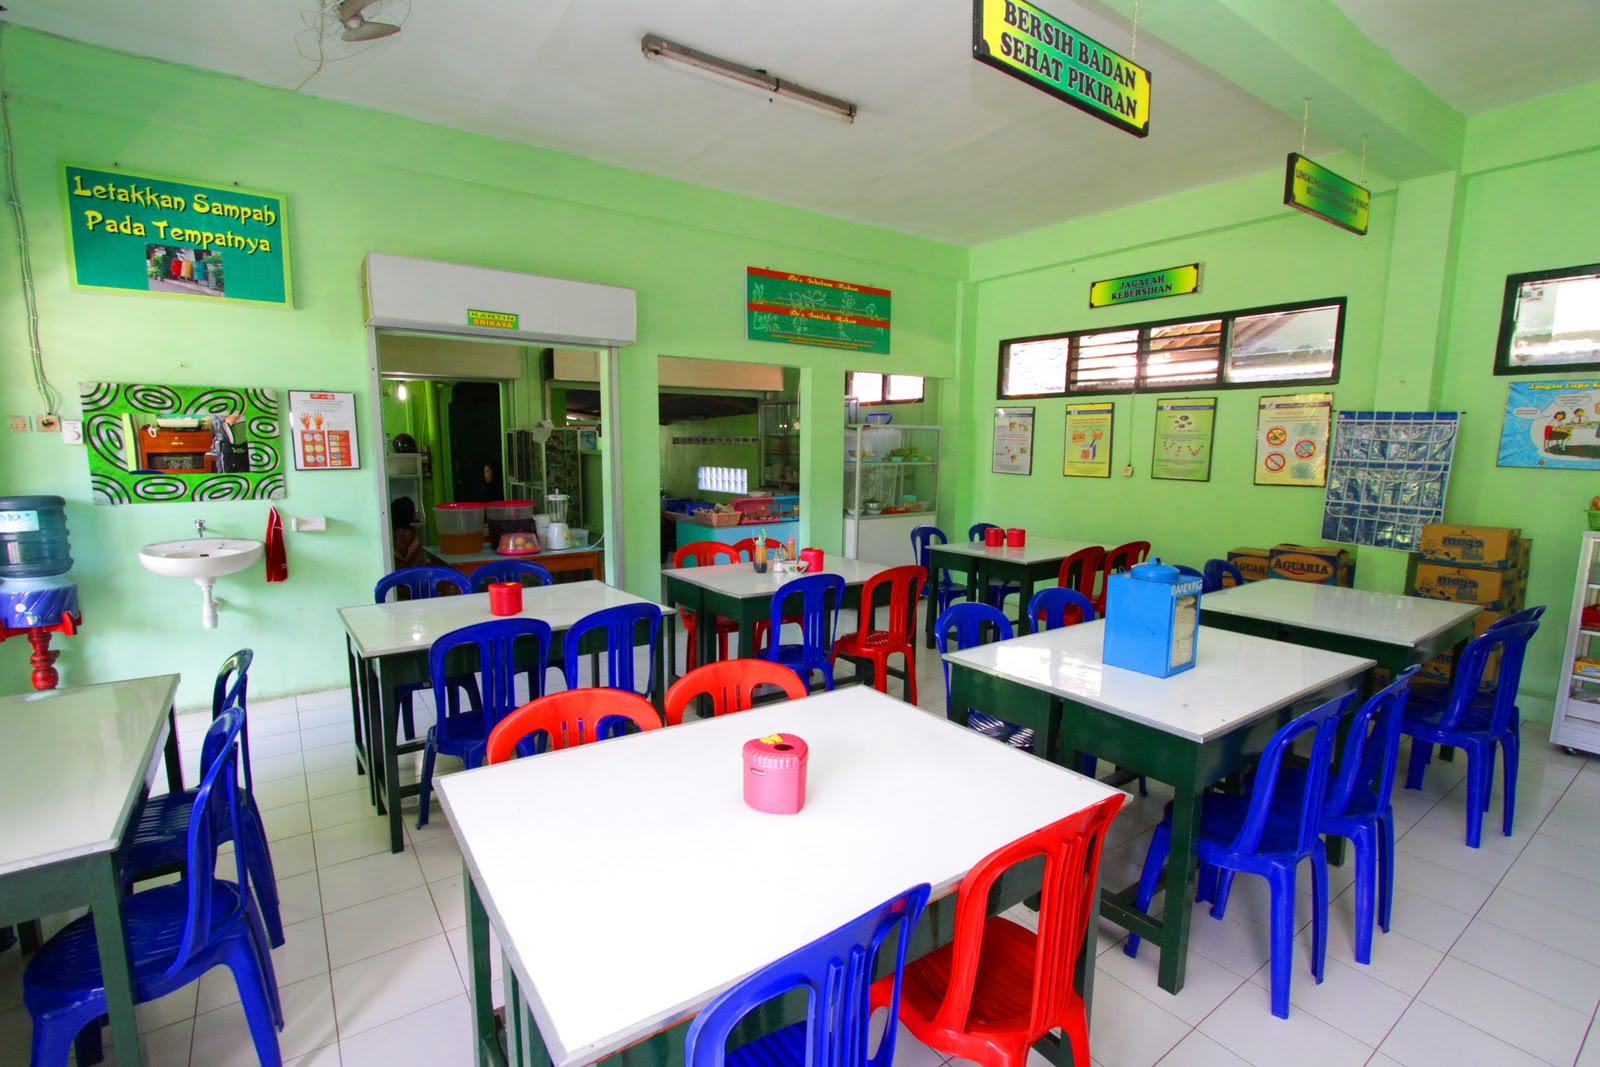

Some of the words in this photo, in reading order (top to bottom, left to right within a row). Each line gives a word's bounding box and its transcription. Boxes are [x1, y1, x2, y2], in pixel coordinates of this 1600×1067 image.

[1004, 1, 1074, 58] BERSIH
[1078, 40, 1136, 90] BADAN
[1000, 32, 1064, 82] SEHAT
[1067, 66, 1138, 120] PIKIRAN
[73, 176, 186, 212] Letakkan
[192, 194, 277, 226] Sampah
[84, 210, 146, 236] Pada
[151, 220, 272, 254] Tempatnya
[1120, 274, 1164, 290] JAGALAH
[1111, 284, 1172, 300] KEBERSIHAN
[470, 312, 514, 321] KANTIN
[474, 319, 513, 328] SRIKAYA
[1274, 558, 1330, 574] AGUARIA
[1171, 579, 1203, 596] BANDUNG
